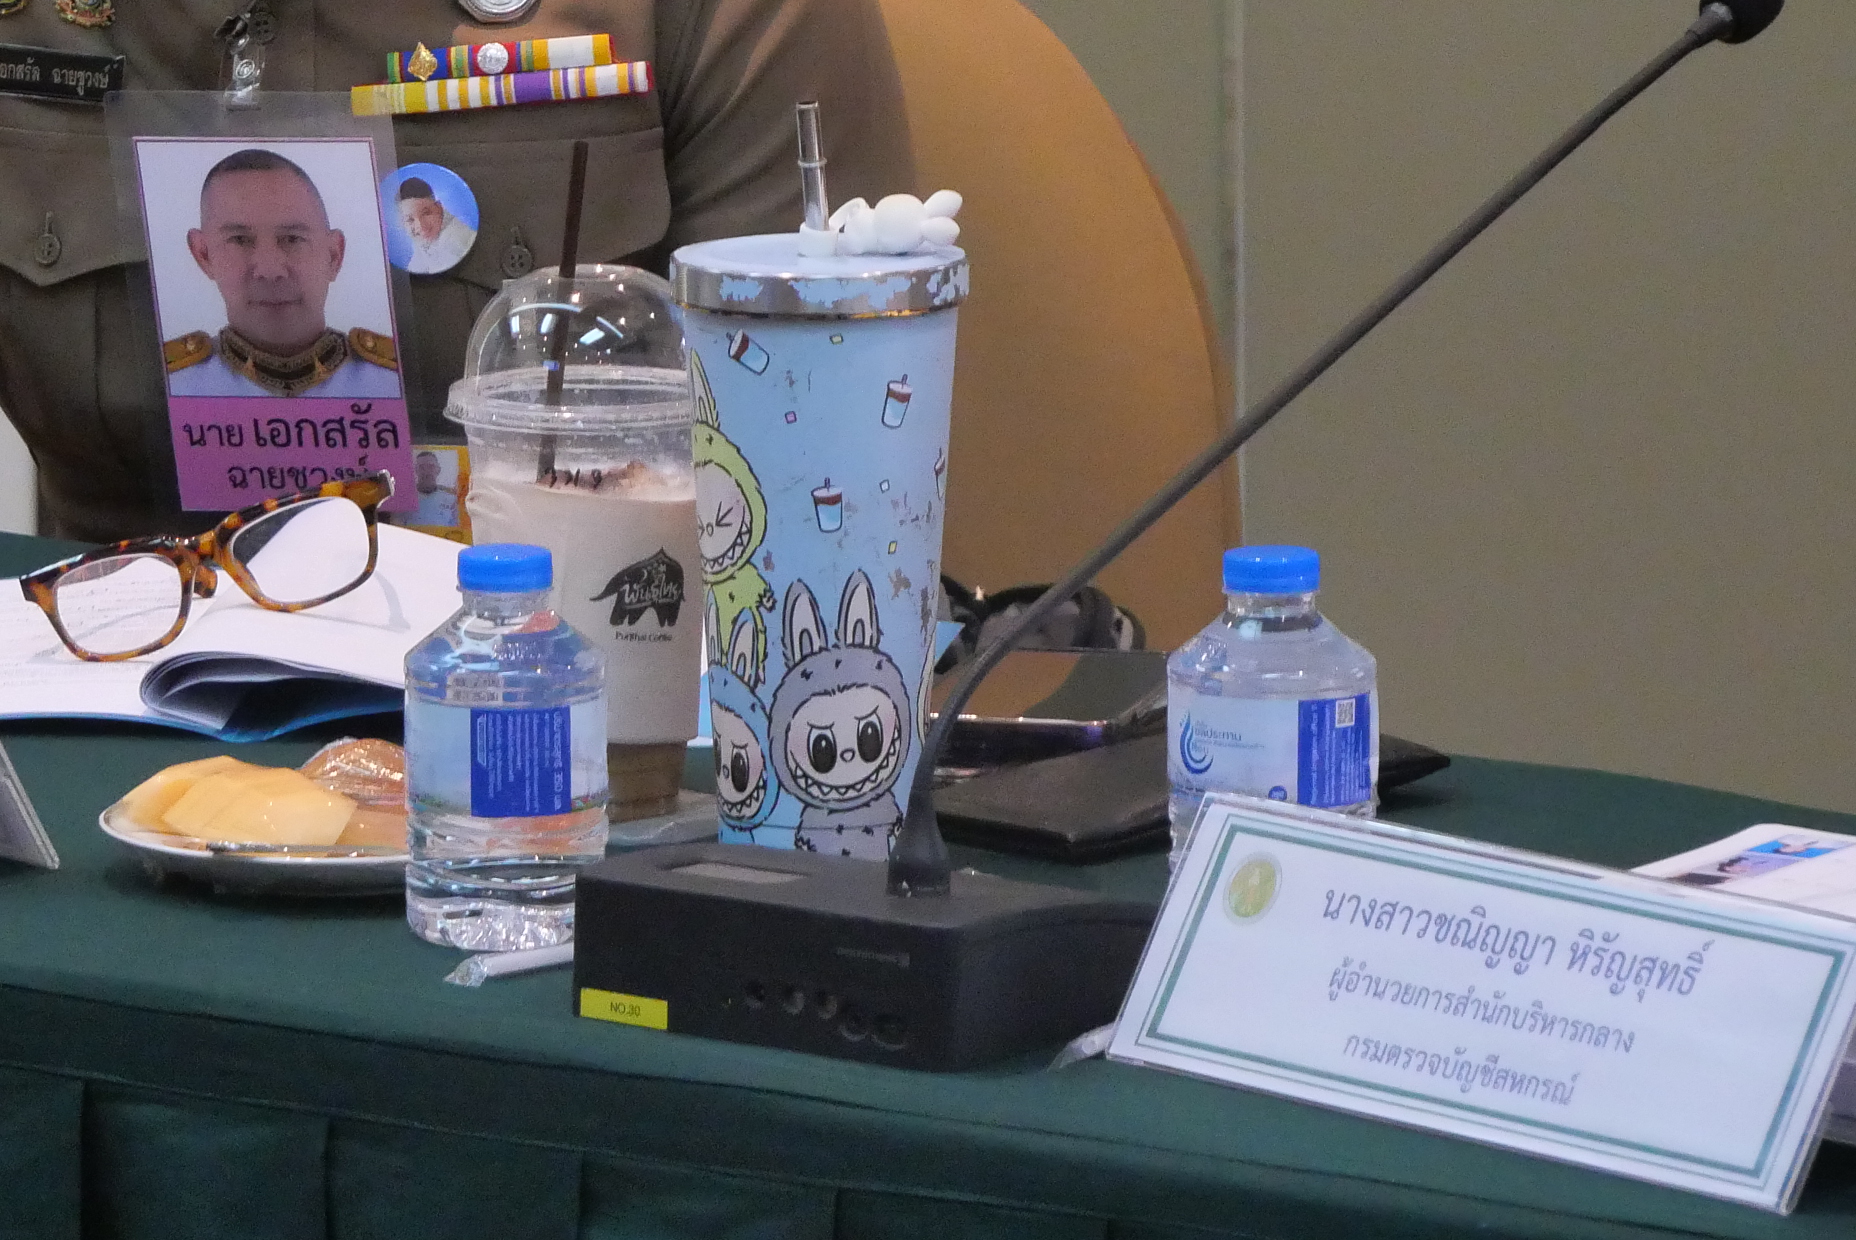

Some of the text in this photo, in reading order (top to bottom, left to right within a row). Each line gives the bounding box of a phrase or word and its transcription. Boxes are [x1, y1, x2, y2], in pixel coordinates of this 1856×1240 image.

[182, 401, 400, 451] นาย เอกสรัล
[1323, 889, 1715, 1004] นางสาวชณิญญา หิรัญสุทธิ์
[1328, 956, 1636, 1053] ผู้อำนวยการสำนักบริหารกลาง
[1343, 1033, 1581, 1106] กรมตรวจบัญชีสหกรณ์
